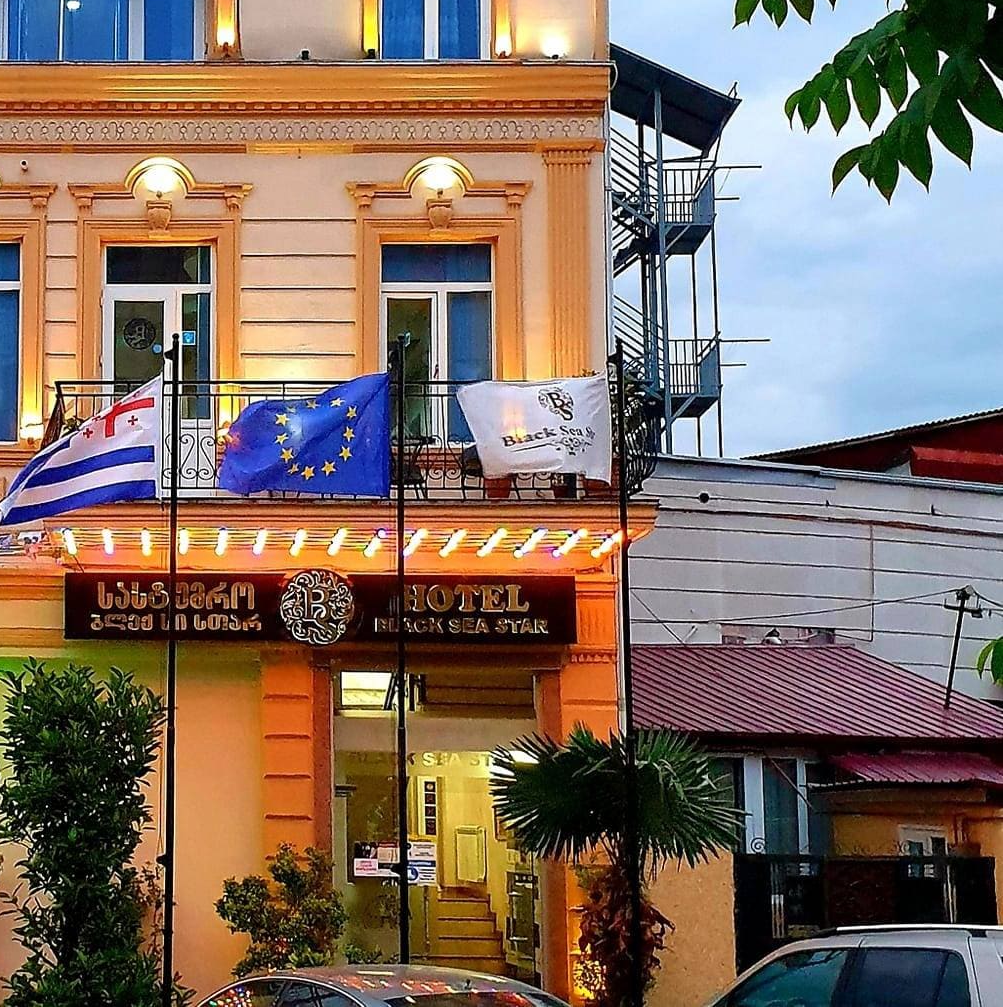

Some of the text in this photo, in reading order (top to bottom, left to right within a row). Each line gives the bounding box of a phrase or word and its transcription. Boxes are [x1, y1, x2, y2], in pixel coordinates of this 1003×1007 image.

[502, 427, 556, 447] Black
[559, 425, 583, 437] Sea
[97, 581, 255, 610] სასტუმრო
[398, 584, 530, 612] HOTEL
[448, 618, 490, 633] SEA
[494, 618, 549, 634] STAR
